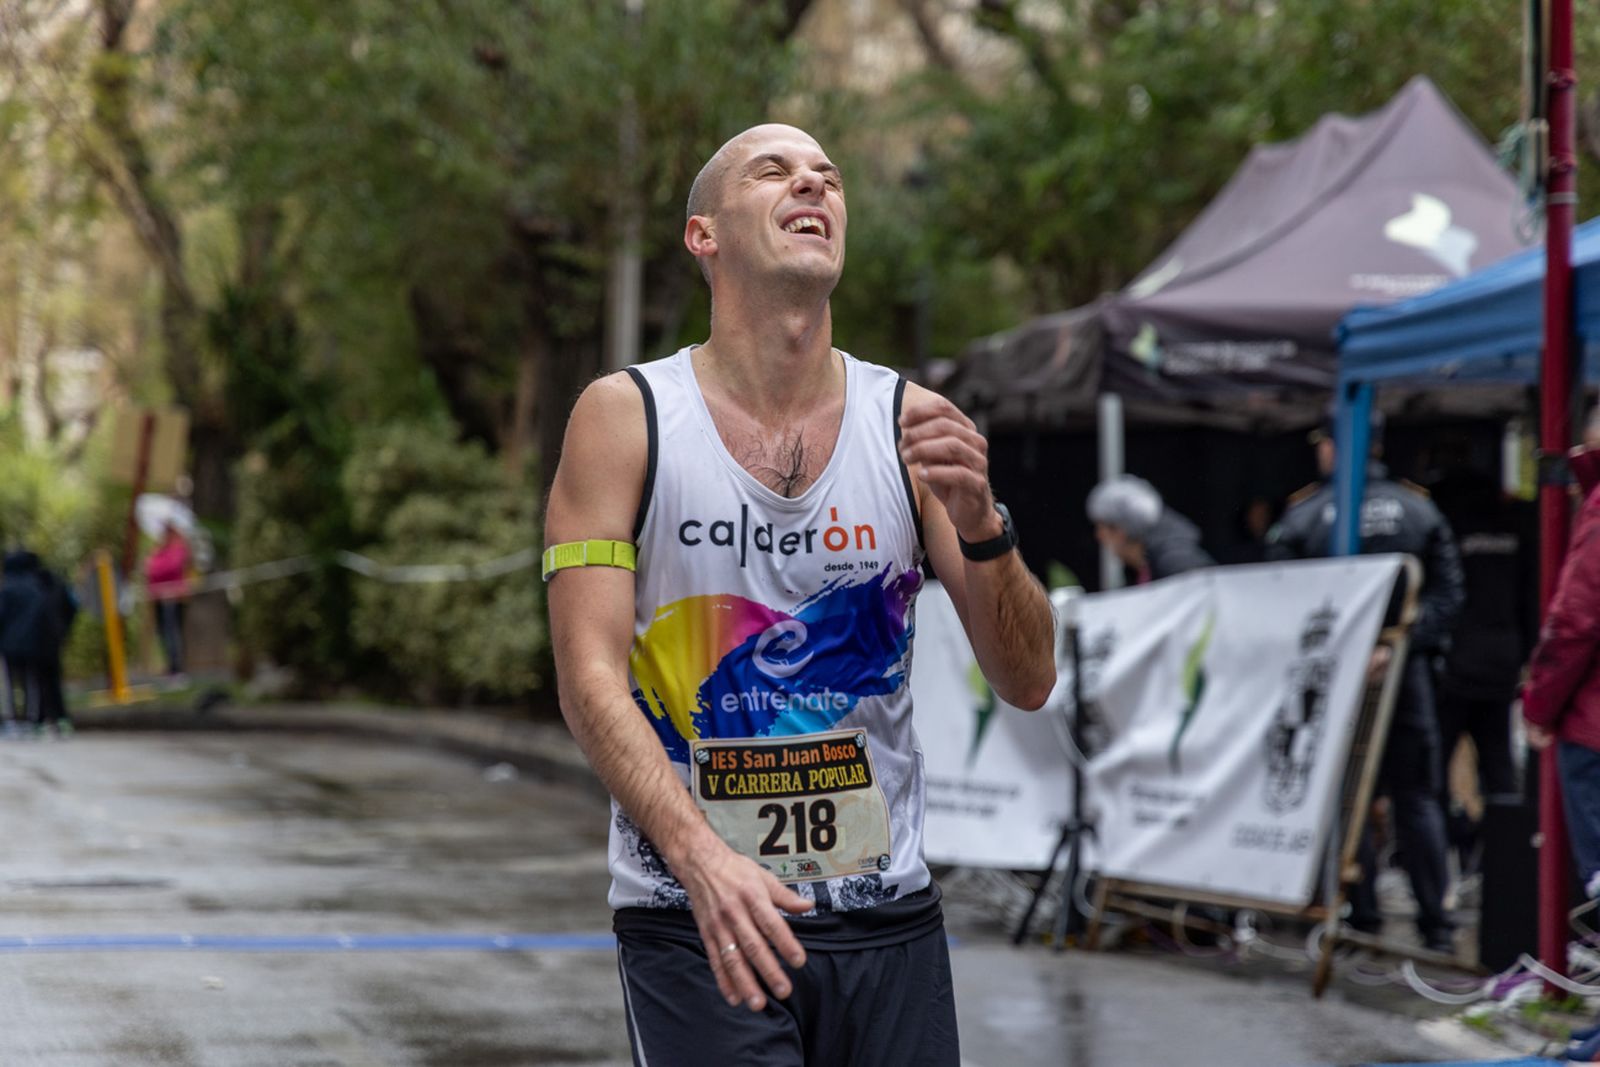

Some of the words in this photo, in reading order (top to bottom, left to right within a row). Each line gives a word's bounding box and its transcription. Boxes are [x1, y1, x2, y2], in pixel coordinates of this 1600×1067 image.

[679, 504, 877, 568] calderón
[824, 562, 854, 572] desde
[859, 561, 879, 571] 1949
[720, 685, 849, 713] entrénate
[712, 751, 737, 770] IES
[743, 750, 776, 769] San
[781, 747, 820, 767] Juan
[822, 743, 856, 762] Bosco
[707, 774, 719, 796] V
[724, 771, 804, 796] CARRERA
[808, 763, 868, 789] POPULAR
[758, 799, 837, 856] 218
